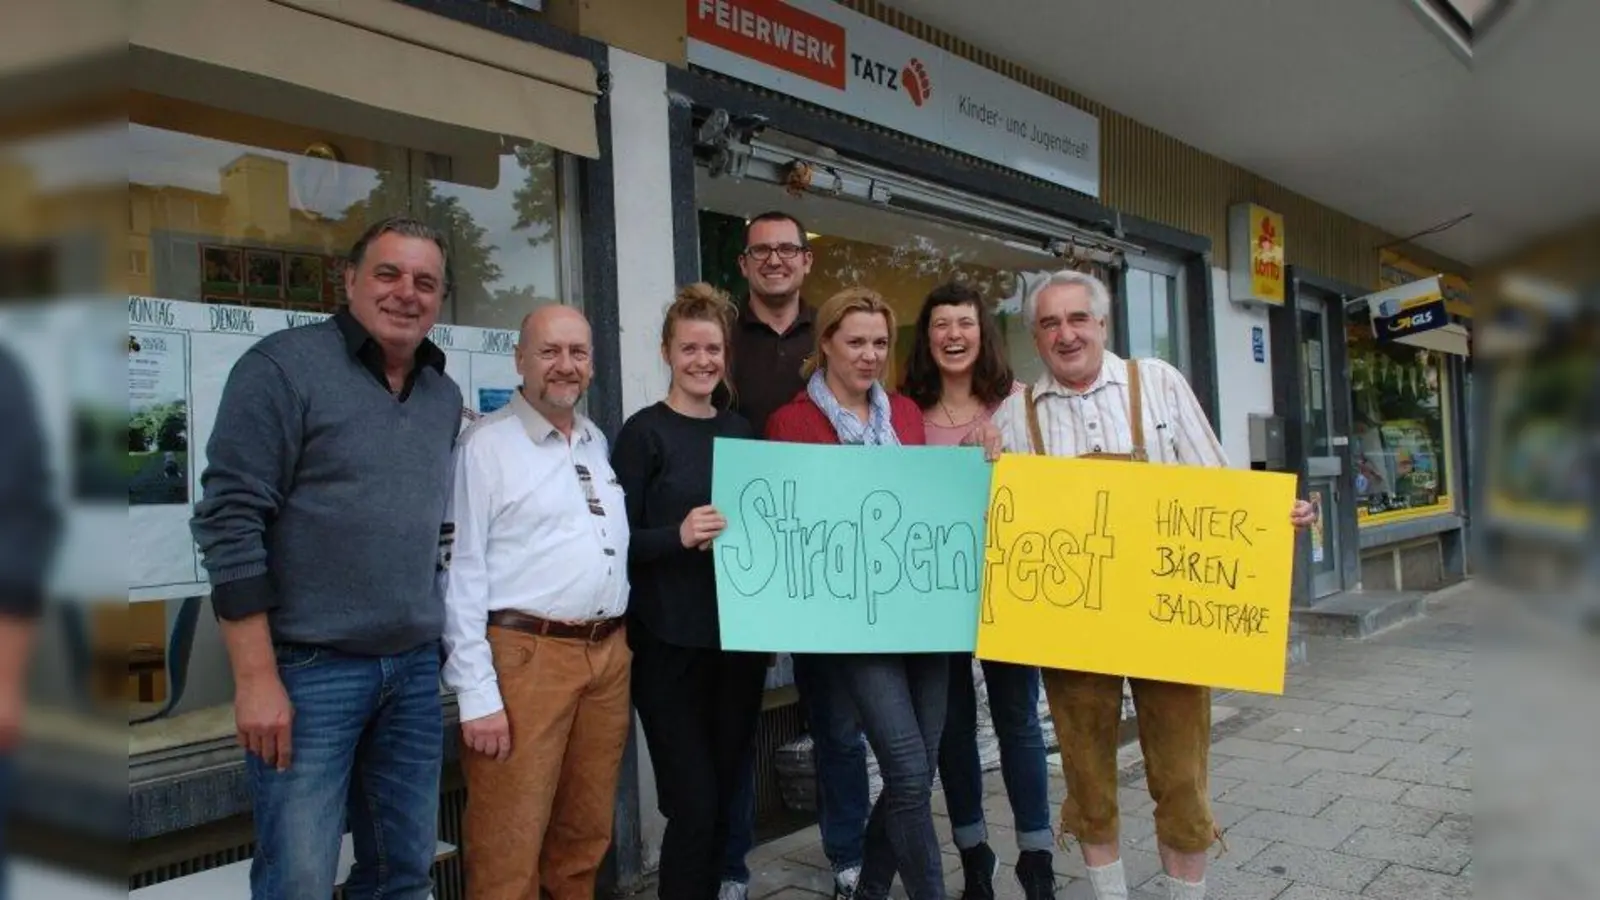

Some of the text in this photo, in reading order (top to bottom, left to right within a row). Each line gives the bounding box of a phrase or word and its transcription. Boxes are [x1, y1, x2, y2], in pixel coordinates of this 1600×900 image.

[698, 0, 836, 68] FEIERWERK
[851, 53, 898, 91] TATZ
[958, 95, 1089, 159] Kinder- und Jugendtreff
[1254, 255, 1280, 281] LOTTO
[209, 304, 254, 332] DIENSTAG
[1411, 311, 1433, 326] GLS
[1155, 499, 1267, 546] HINTER-
[1151, 544, 1256, 590] BÄREN-
